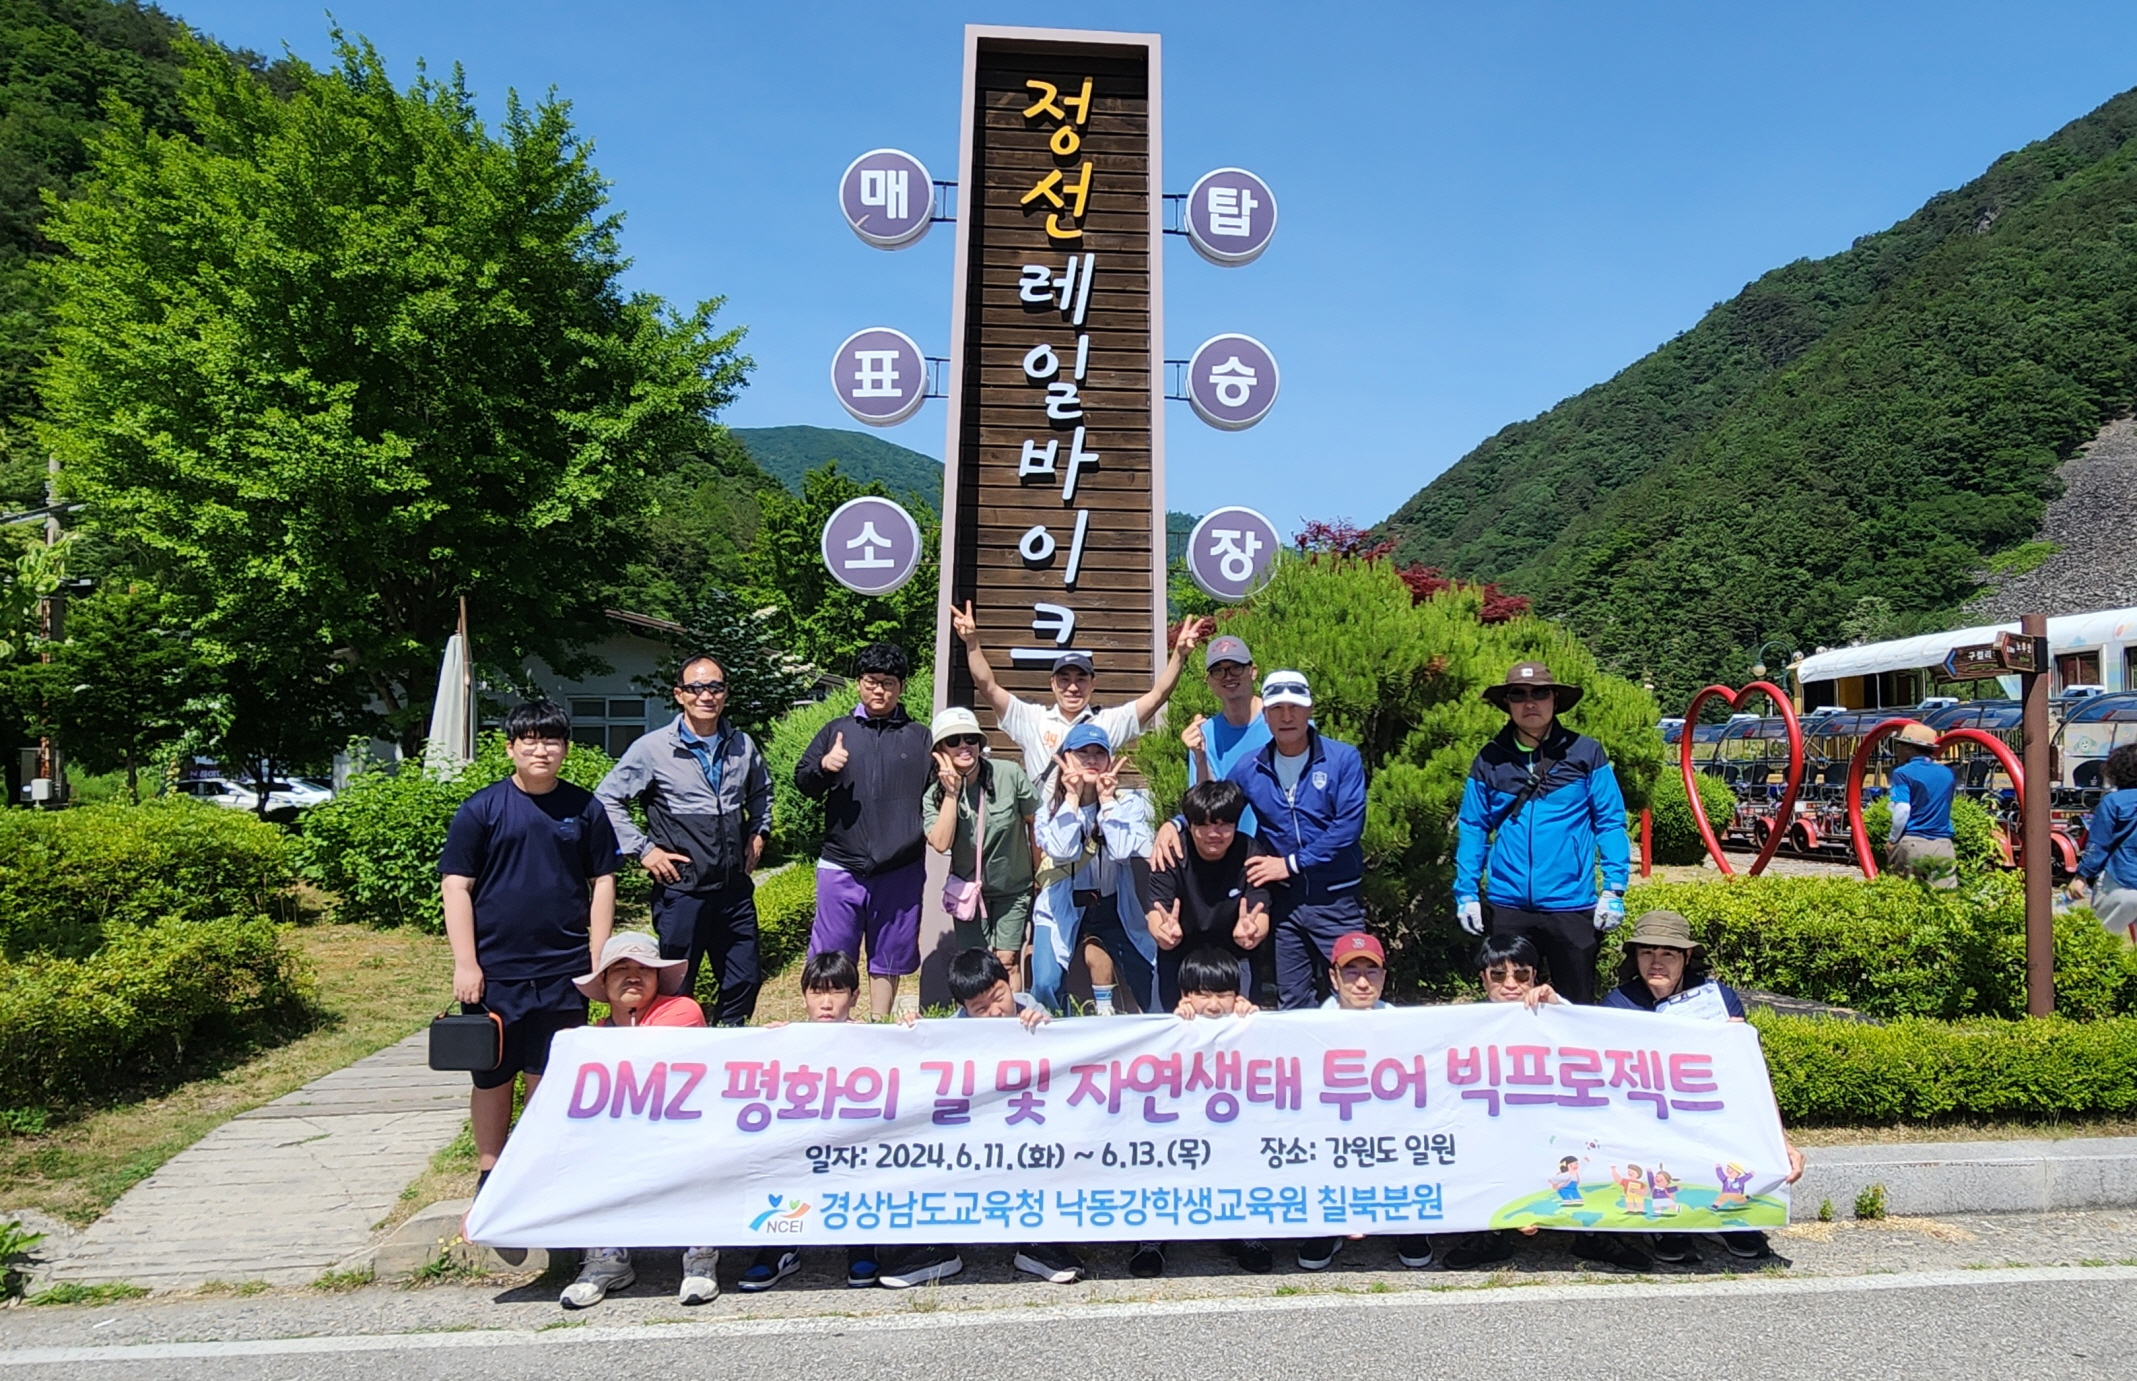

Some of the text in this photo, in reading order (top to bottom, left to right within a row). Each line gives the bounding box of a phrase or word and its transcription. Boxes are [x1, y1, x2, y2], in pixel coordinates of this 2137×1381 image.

[1011, 77, 1099, 660] 정선 레일바이크
[567, 1044, 1726, 1132] DMZ 평화의 길 및 자연생태 투어 빅프로젝트
[805, 1144, 868, 1174] 일자:
[875, 1142, 1065, 1172] 2024.6.11.(화)
[1101, 1138, 1212, 1171] 6.13.(목)
[1260, 1133, 1456, 1169] 장소: 강원도 일원
[766, 1220, 804, 1234] NCEI
[819, 1182, 1445, 1231] 경상남도교육청 낙동강학생교육원 칠북분원
